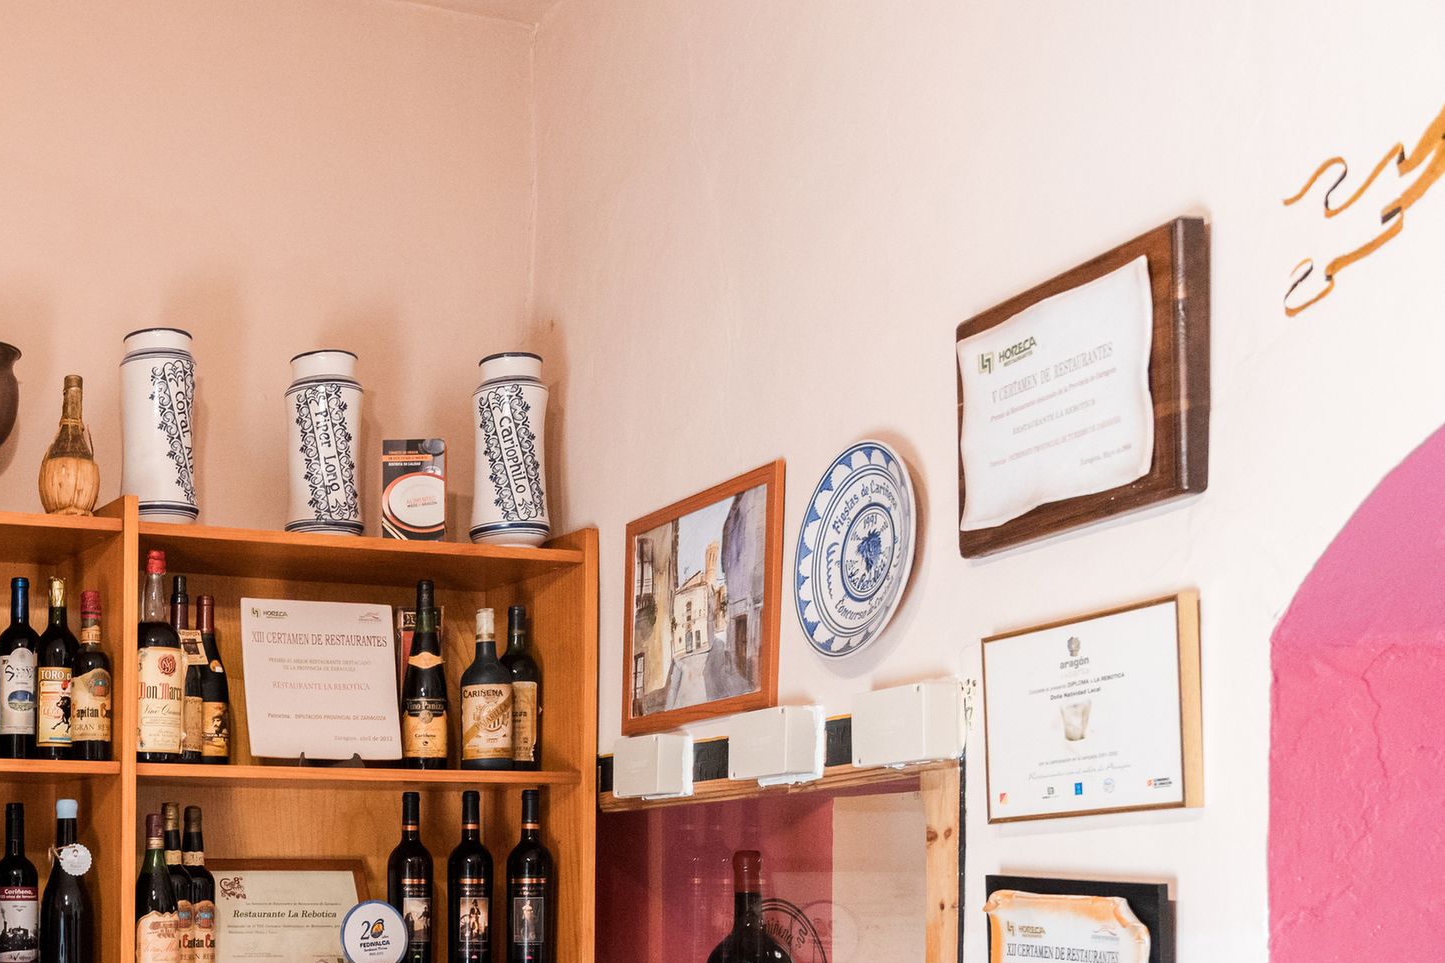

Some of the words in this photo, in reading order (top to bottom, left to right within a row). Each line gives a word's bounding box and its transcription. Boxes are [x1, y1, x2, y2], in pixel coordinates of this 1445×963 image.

[998, 336, 1038, 363] HORECA
[998, 375, 1038, 402] CERTAMEN
[1040, 367, 1052, 385] DE
[1053, 341, 1114, 380] RESTAURANTES
[860, 483, 870, 498] de
[252, 631, 265, 643] XIII
[266, 633, 310, 645] CERTAMEN
[311, 634, 324, 646] DE
[325, 635, 388, 648] RESTAURANTES
[1059, 656, 1090, 670] aragón
[41, 669, 65, 680] TORO
[272, 681, 322, 690] RESTAURANTE
[323, 682, 332, 690] LA
[332, 682, 371, 691] REBOTICA
[463, 688, 504, 699] CARIÑENA
[232, 909, 286, 918] Restaurante
[287, 909, 299, 918] La
[300, 909, 337, 918] Rebotica
[1017, 943, 1054, 960] CERTAMEN
[1055, 948, 1066, 961] DE
